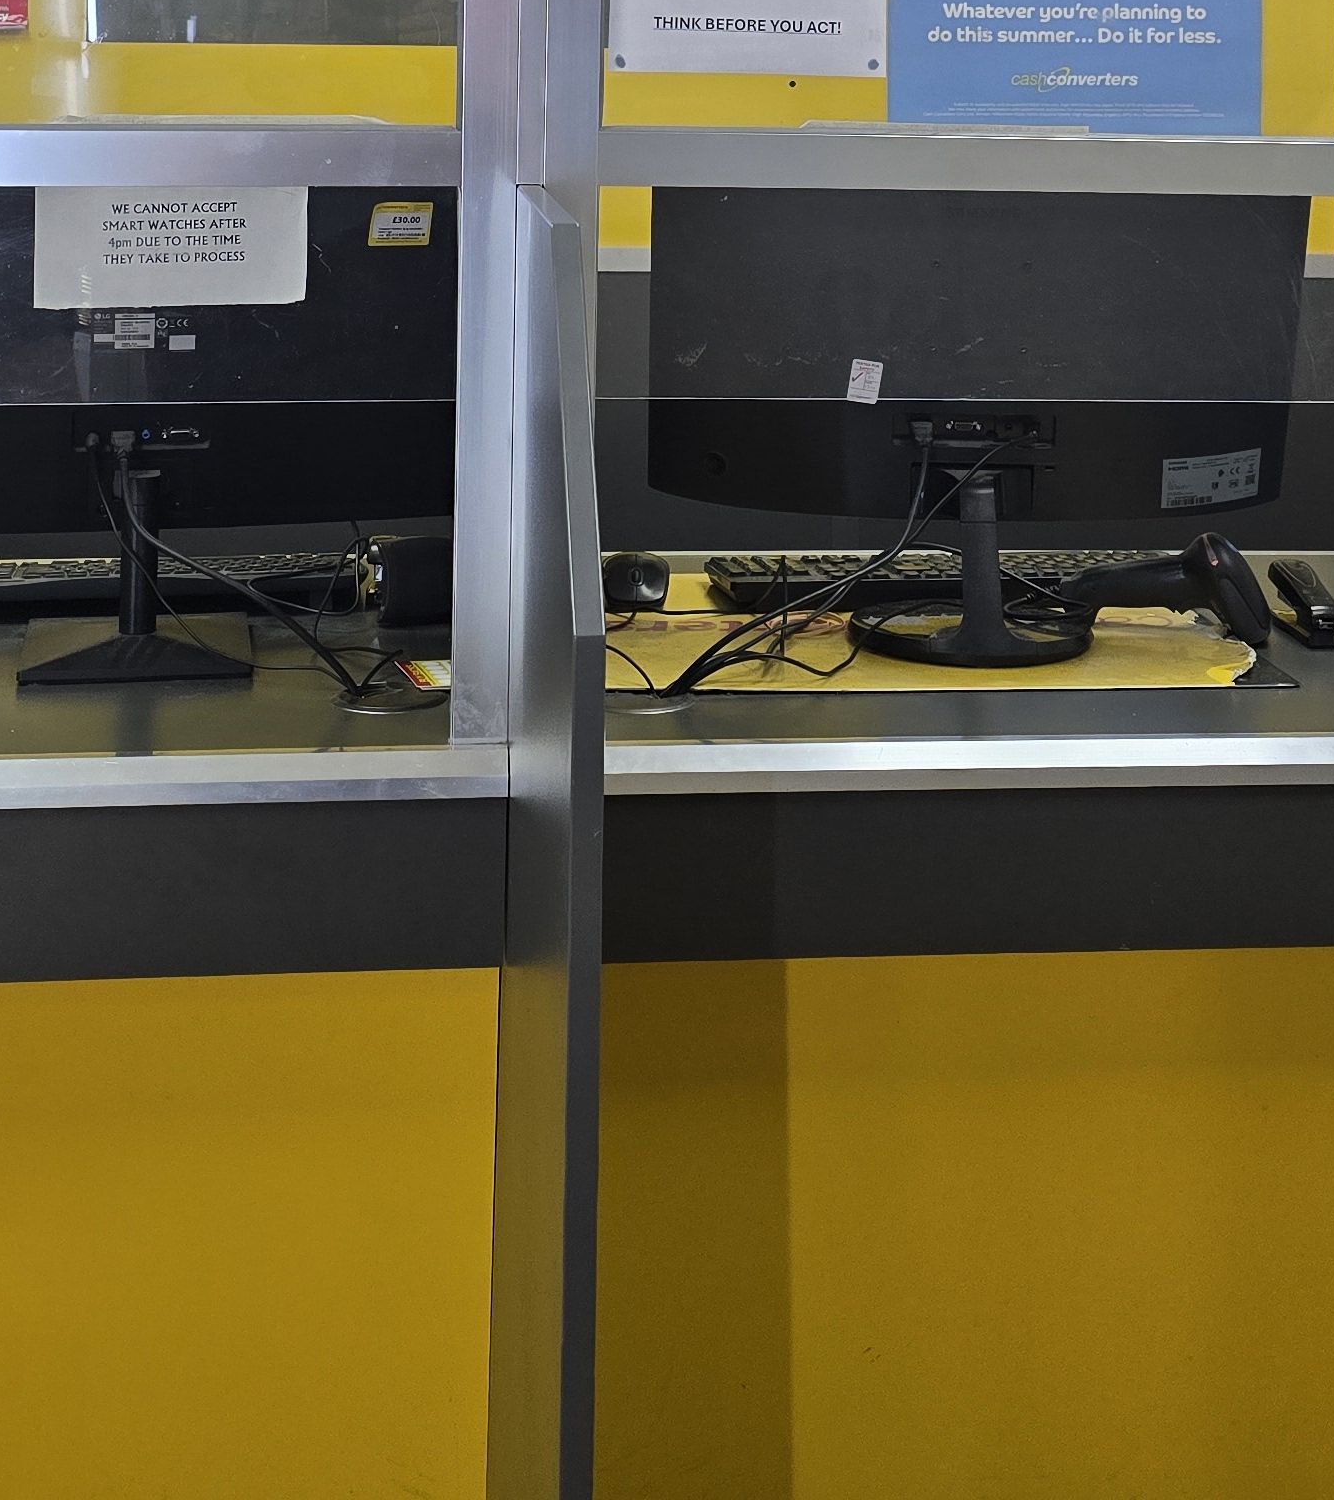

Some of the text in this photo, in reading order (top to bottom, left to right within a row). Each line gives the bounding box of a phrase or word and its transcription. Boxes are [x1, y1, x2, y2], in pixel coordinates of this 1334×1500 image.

[943, 3, 1207, 23] Whatever you're planning to
[654, 16, 841, 35] THINK BEFORE YOU ACT!
[927, 26, 1221, 43] do this summer... Do it for less.
[1011, 72, 1139, 87] cashconverters
[111, 202, 239, 214] WE CANNOT ACCEPT
[102, 218, 247, 231] SMART WATCHES AFTER
[392, 216, 421, 224] £30.00
[109, 235, 241, 249] 4pm DUE TO THE TIME
